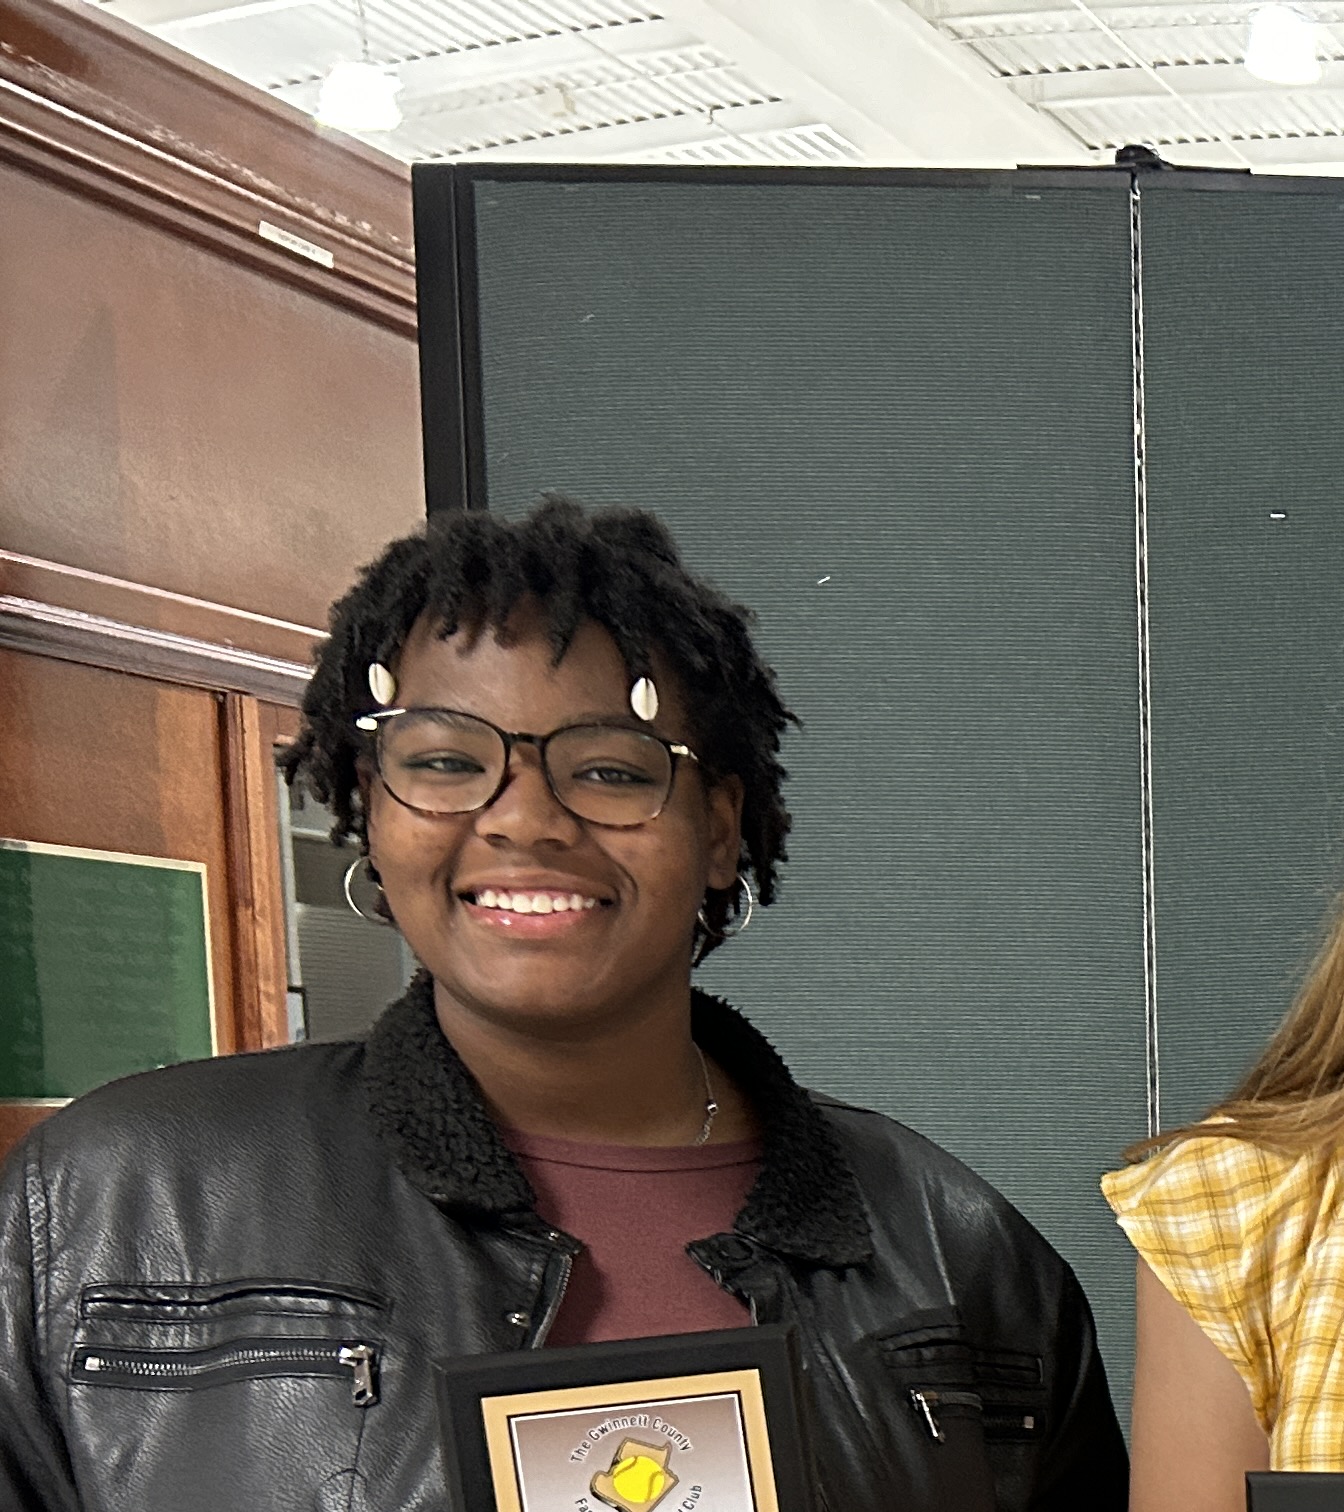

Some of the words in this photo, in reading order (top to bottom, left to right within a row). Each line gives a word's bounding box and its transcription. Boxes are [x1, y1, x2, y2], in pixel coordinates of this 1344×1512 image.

[570, 1440, 590, 1461] The
[589, 1415, 647, 1439] Gwinnett
[652, 1417, 691, 1452] County
[682, 1486, 702, 1511] Club
